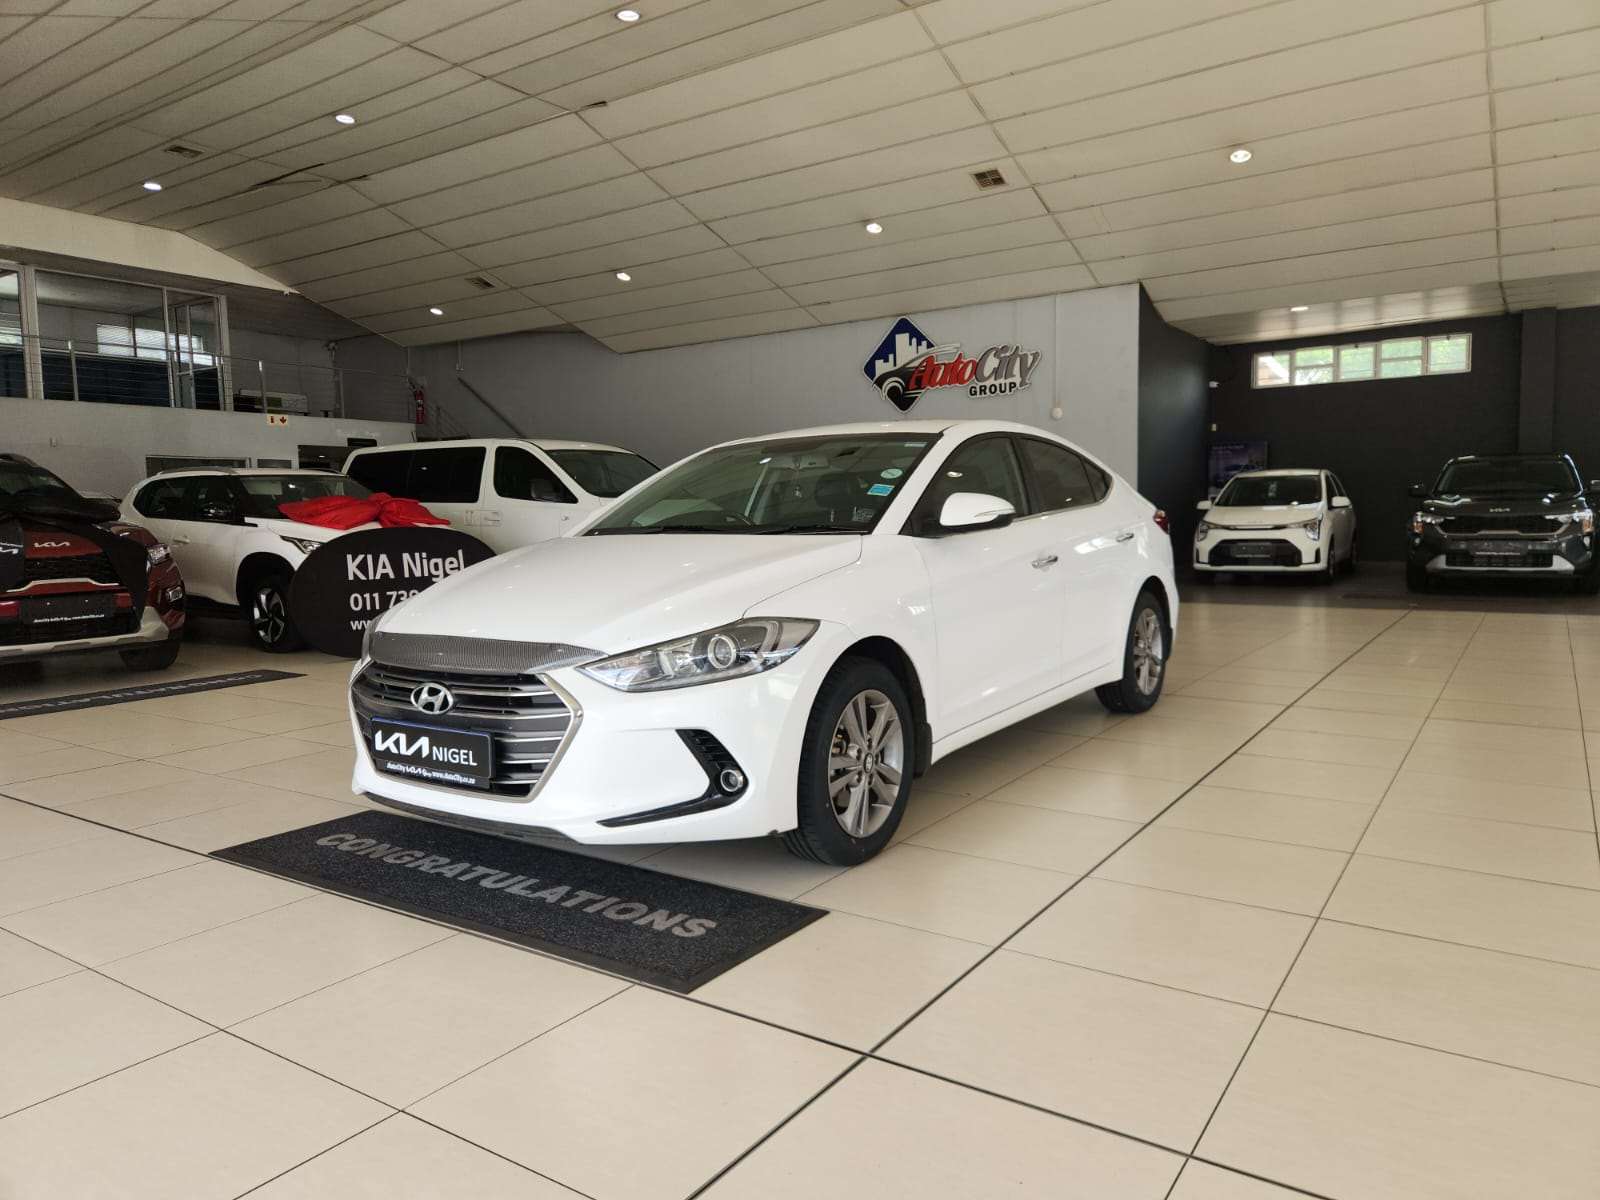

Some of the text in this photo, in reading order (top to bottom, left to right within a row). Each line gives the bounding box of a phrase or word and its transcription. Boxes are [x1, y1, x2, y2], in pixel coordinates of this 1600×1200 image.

[908, 345, 1040, 389] AutoCity
[969, 382, 1017, 397] GROUP
[347, 549, 465, 582] KIA Nigel
[350, 592, 380, 611] 011
[374, 730, 478, 766] KIA NIGEL
[316, 834, 717, 938] CONGRATULATIONS
